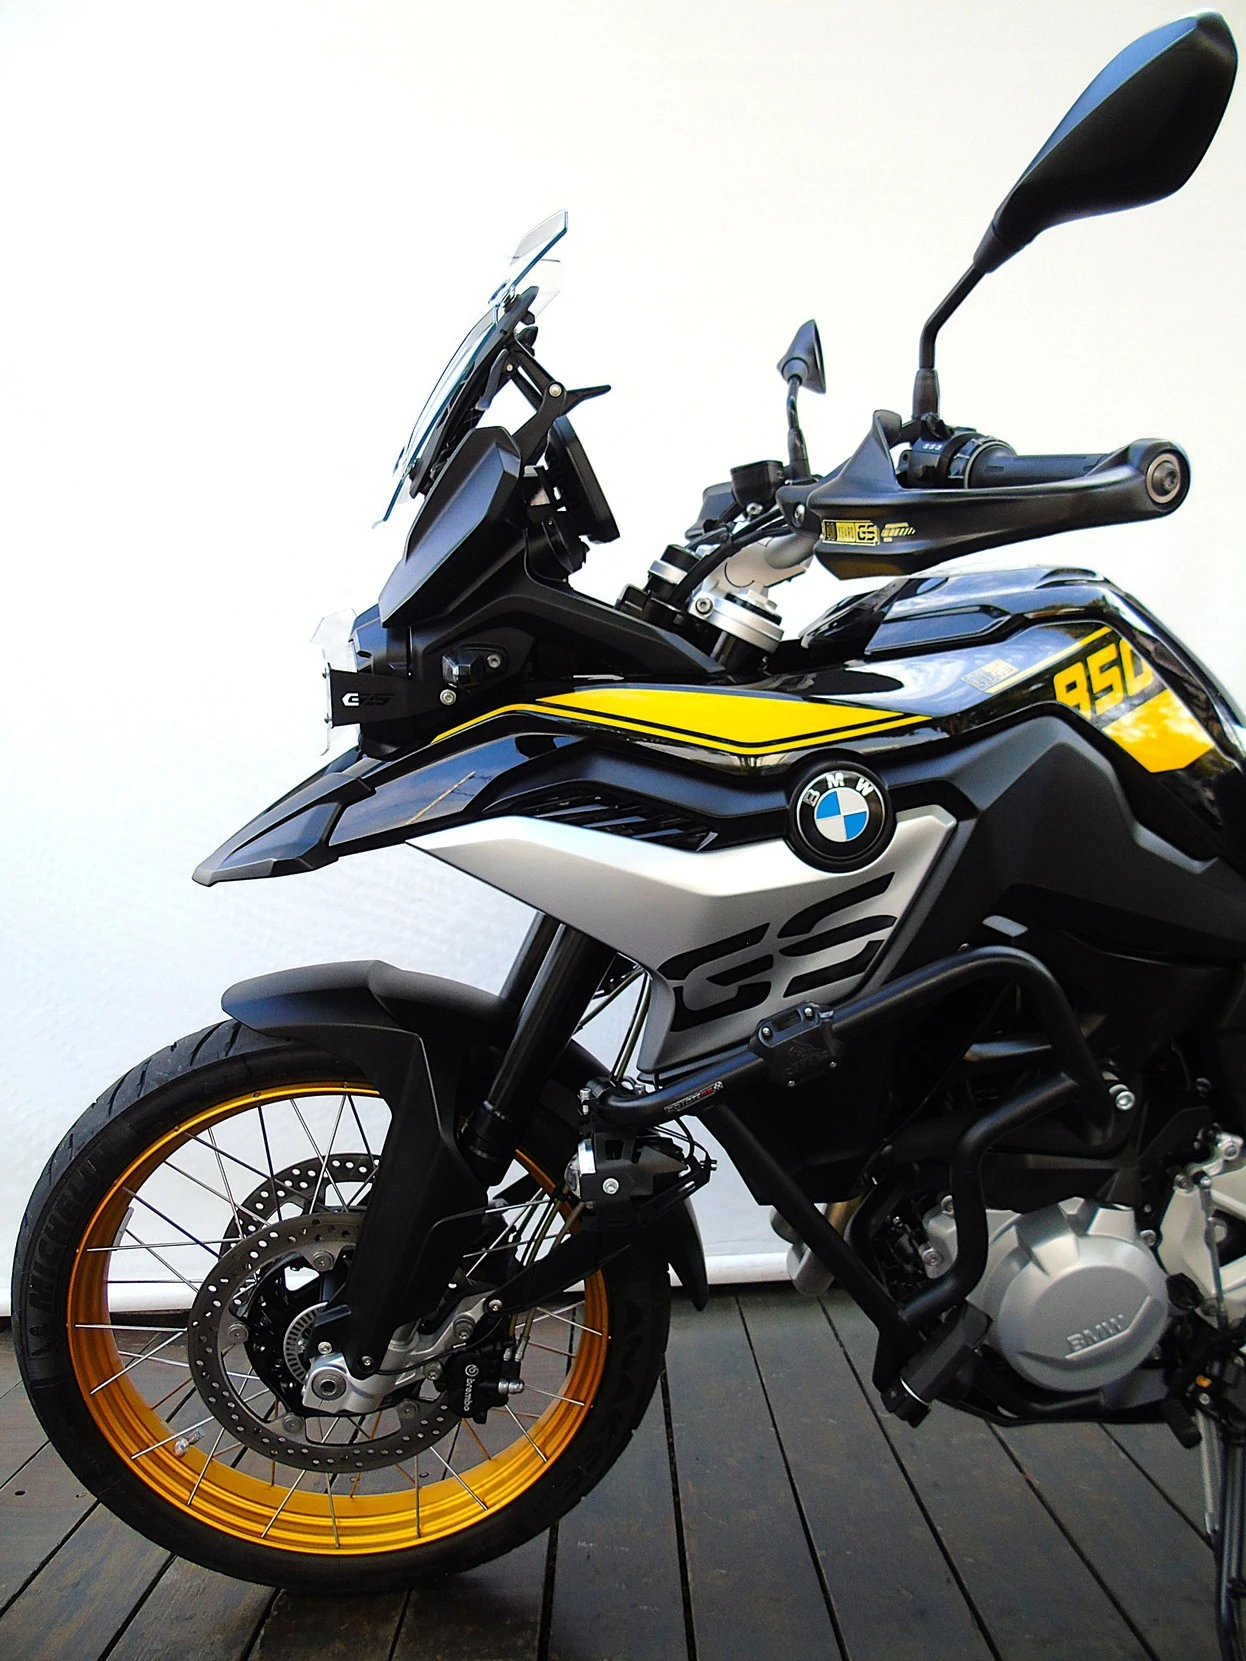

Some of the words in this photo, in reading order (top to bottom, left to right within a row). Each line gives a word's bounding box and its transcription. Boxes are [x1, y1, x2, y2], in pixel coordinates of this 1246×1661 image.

[857, 524, 875, 541] GS
[802, 772, 874, 807] BMW
[657, 871, 898, 1032] GS
[1066, 1313, 1124, 1351] BMW
[463, 1378, 475, 1412] brembo
